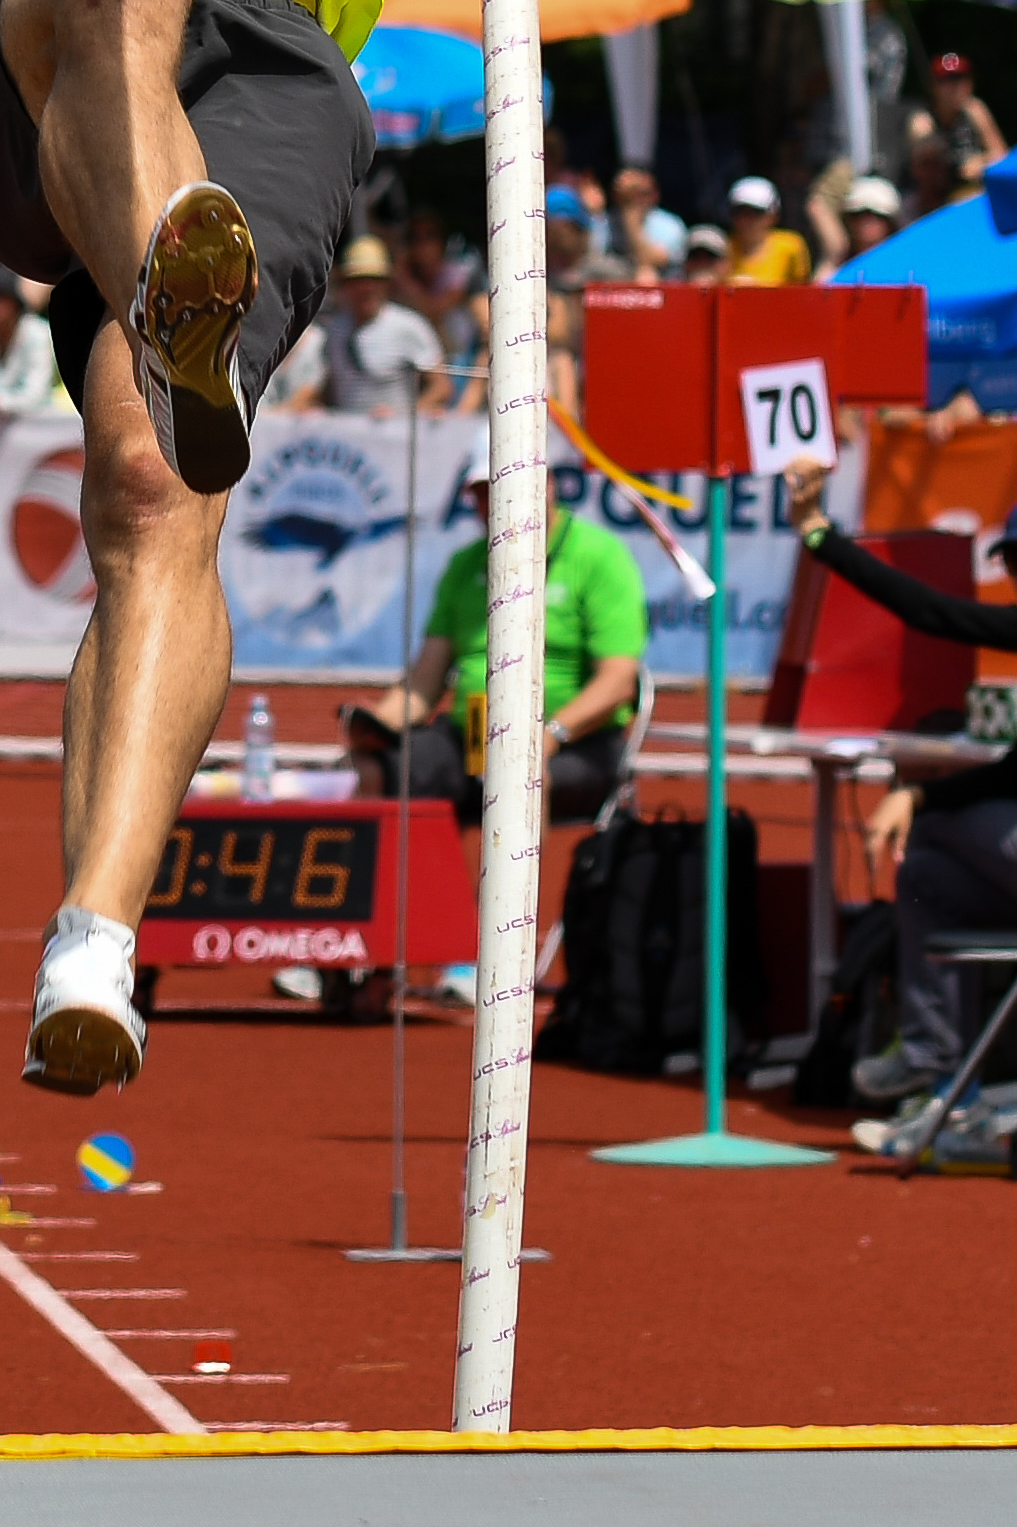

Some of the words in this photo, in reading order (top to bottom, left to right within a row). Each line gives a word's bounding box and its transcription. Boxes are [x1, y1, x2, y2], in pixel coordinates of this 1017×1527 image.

[496, 394, 535, 415] UCS
[756, 384, 817, 445] 70
[489, 460, 525, 485] UCS
[496, 913, 536, 934] UCS
[232, 926, 368, 962] OMEGA
[483, 985, 523, 1007] UCS
